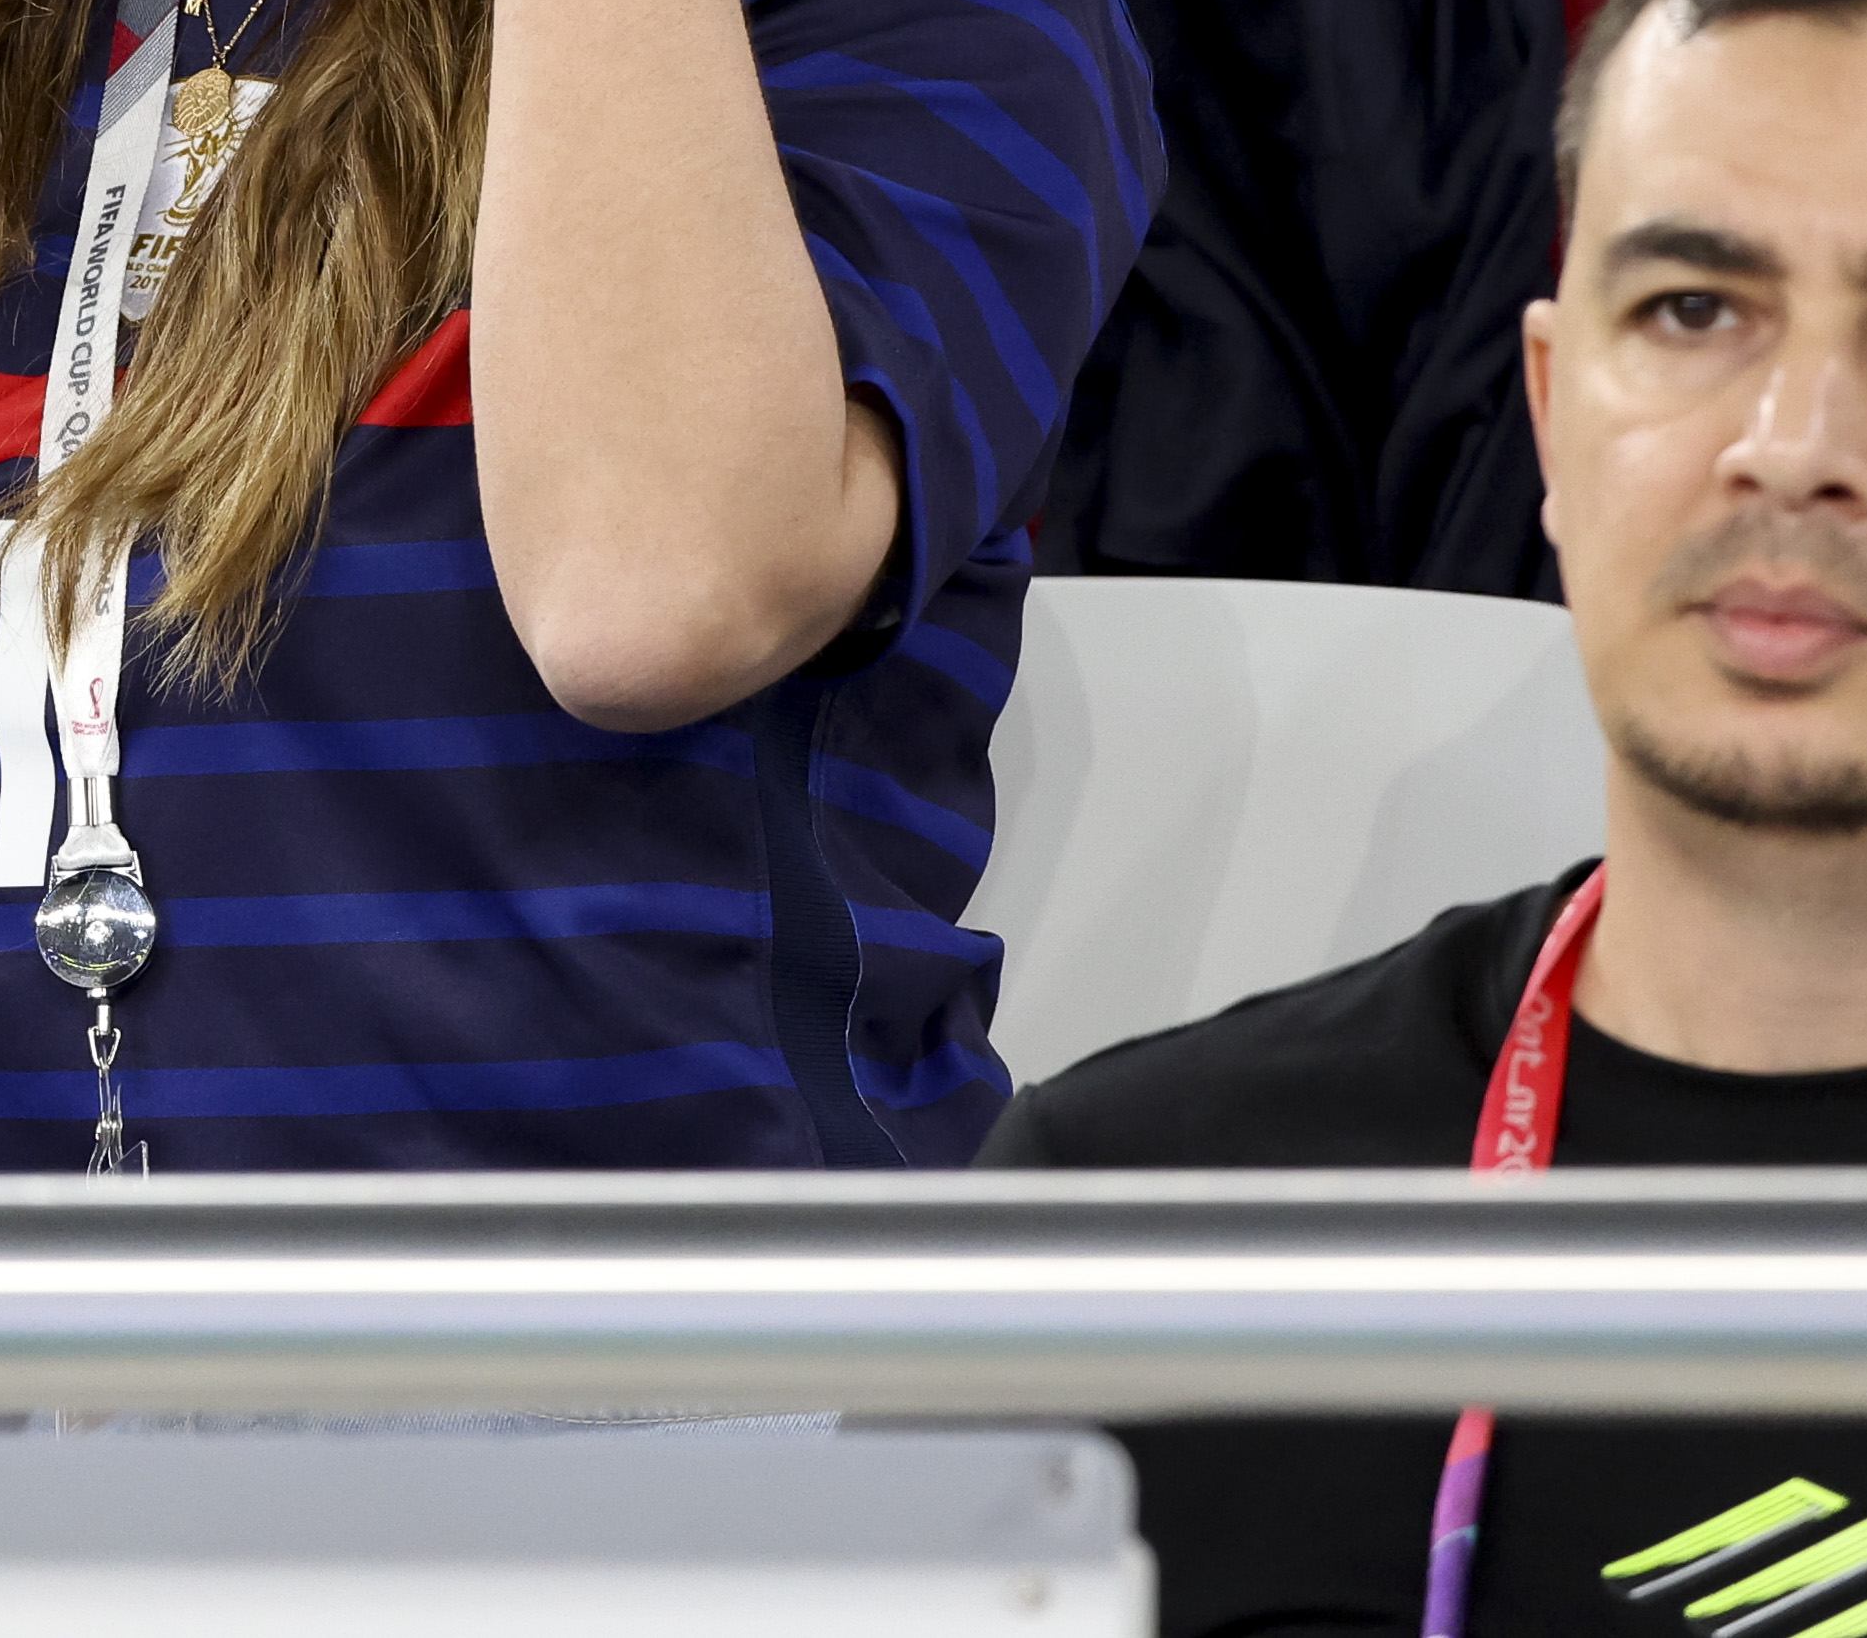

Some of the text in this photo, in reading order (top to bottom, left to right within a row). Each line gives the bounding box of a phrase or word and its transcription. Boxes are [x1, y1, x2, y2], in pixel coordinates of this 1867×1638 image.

[93, 184, 127, 242] FIFA
[130, 232, 185, 260] FIF
[75, 242, 108, 337] WORLD
[128, 273, 162, 291] 201
[67, 342, 94, 399] CUP
